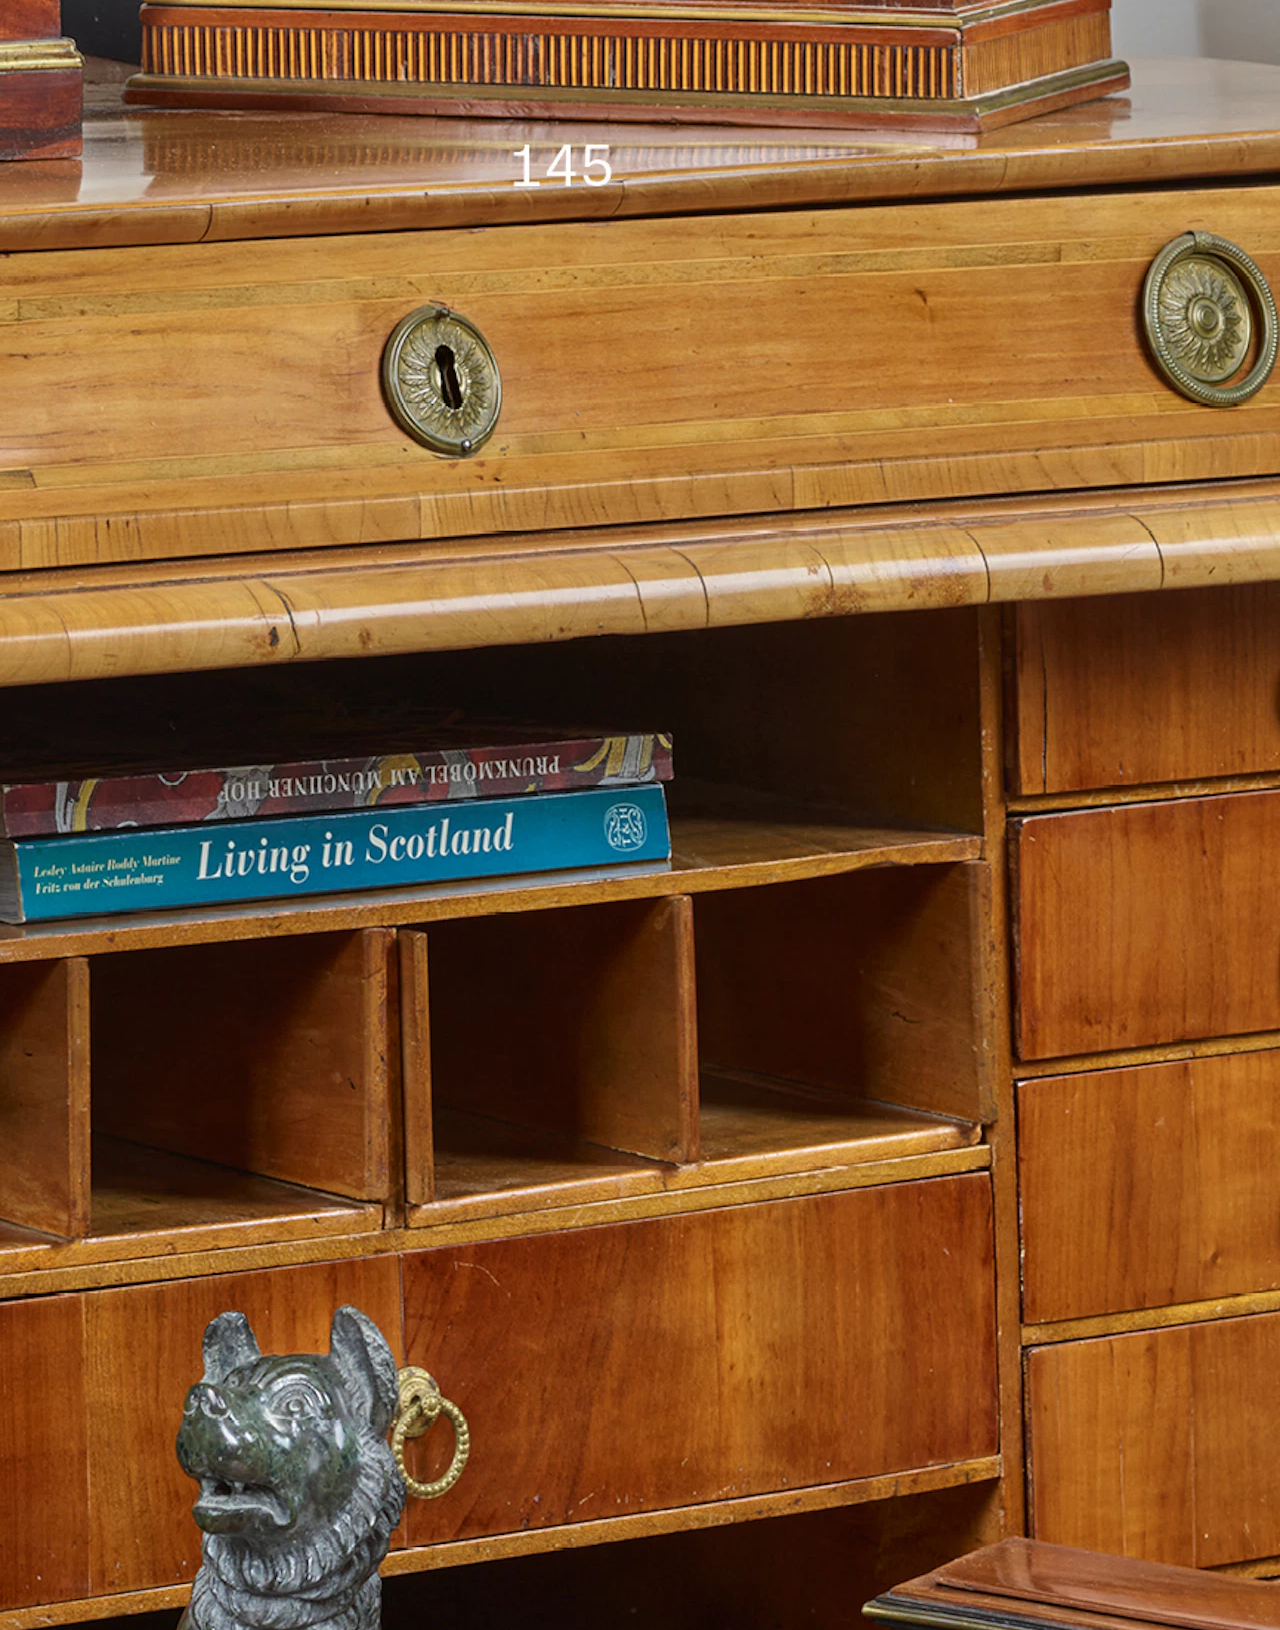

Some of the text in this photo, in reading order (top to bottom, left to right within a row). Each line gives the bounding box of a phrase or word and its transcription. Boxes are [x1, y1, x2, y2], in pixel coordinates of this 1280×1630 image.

[220, 755, 560, 803] PRUNKMÖBEL AM MÜNCHNER HOF
[197, 812, 515, 885] Living in Scotland
